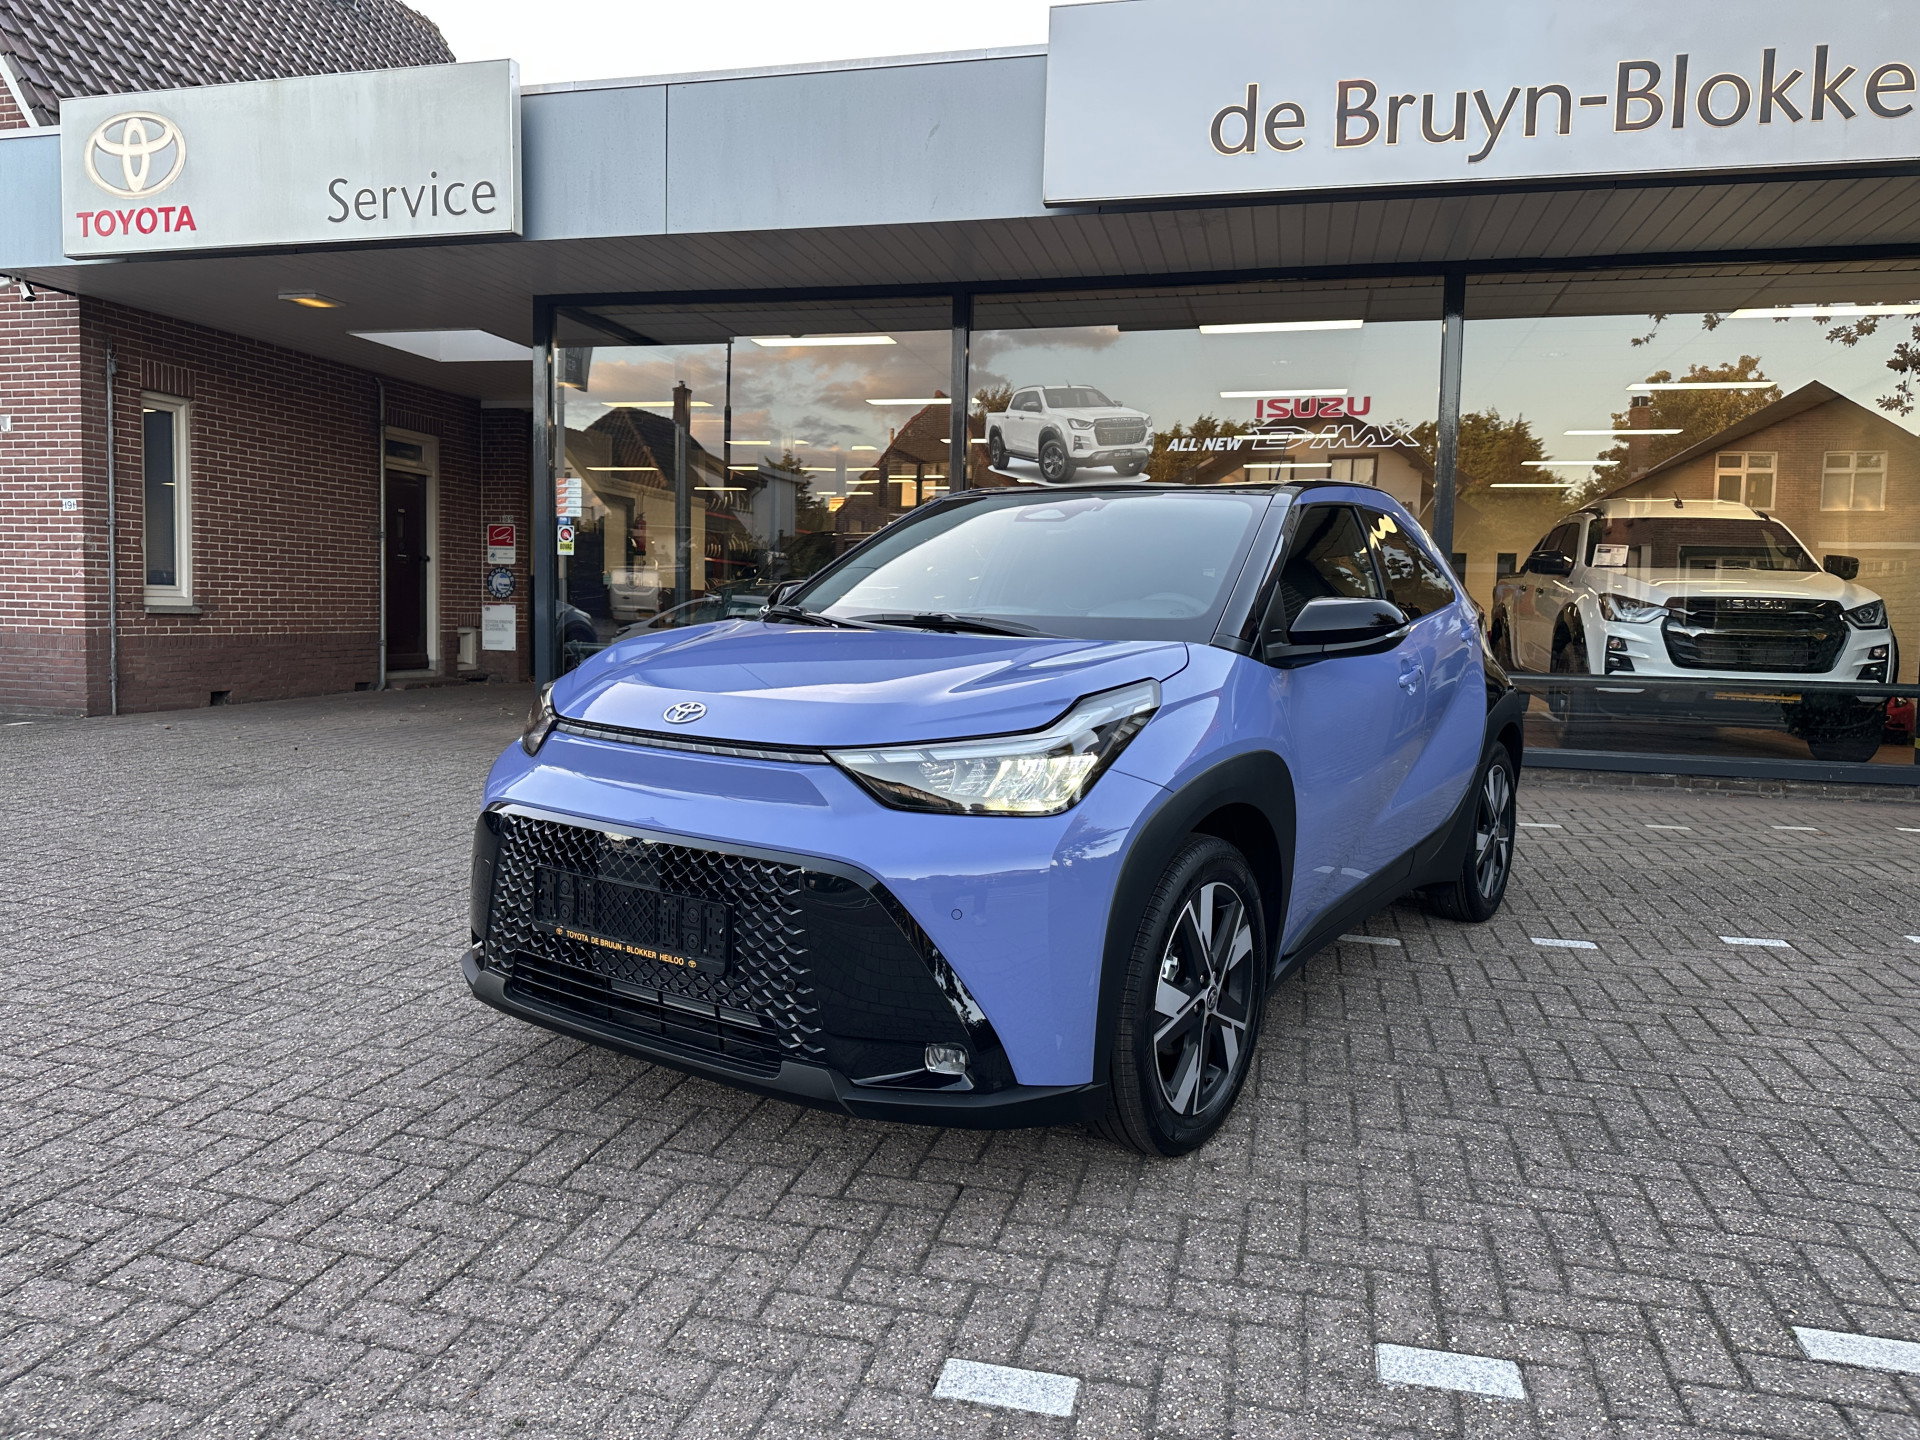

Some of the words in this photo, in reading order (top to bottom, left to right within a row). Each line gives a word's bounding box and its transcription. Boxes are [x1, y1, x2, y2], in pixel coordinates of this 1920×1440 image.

[1209, 82, 1306, 156] de
[327, 171, 496, 223] Service
[76, 205, 197, 238] TOYOTA
[1256, 396, 1371, 419] ISUZU
[1166, 437, 1199, 452] ALL
[1201, 436, 1244, 451] NEW
[1251, 424, 1421, 450] D-MAX
[1726, 599, 1787, 610] ISUZU
[566, 930, 589, 942] TOYOTA
[590, 936, 599, 945] DE
[600, 938, 622, 951] BRUIJN
[626, 945, 657, 960] BLOKKER
[659, 953, 684, 966] HEILOO
